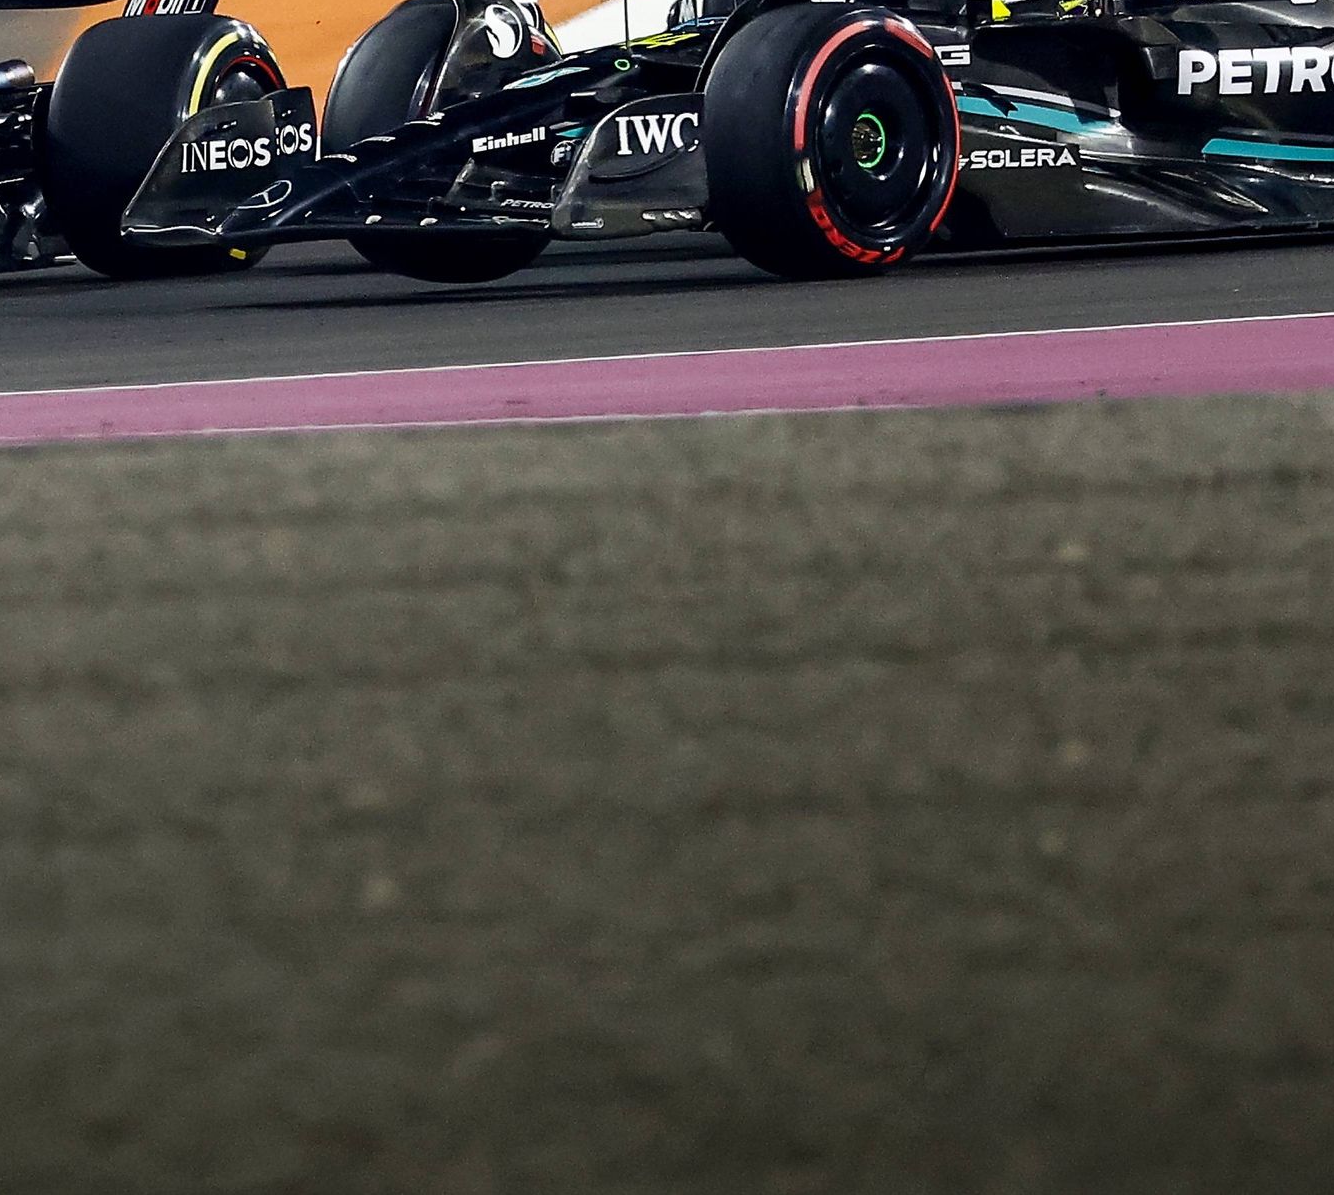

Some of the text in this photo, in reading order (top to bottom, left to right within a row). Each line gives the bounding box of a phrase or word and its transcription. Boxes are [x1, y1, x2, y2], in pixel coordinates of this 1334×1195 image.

[472, 126, 546, 153] Einhell
[615, 112, 700, 156] IWC
[181, 137, 271, 173] INEOS
[970, 148, 1077, 169] SOLERA
[500, 198, 555, 209] PETRO
